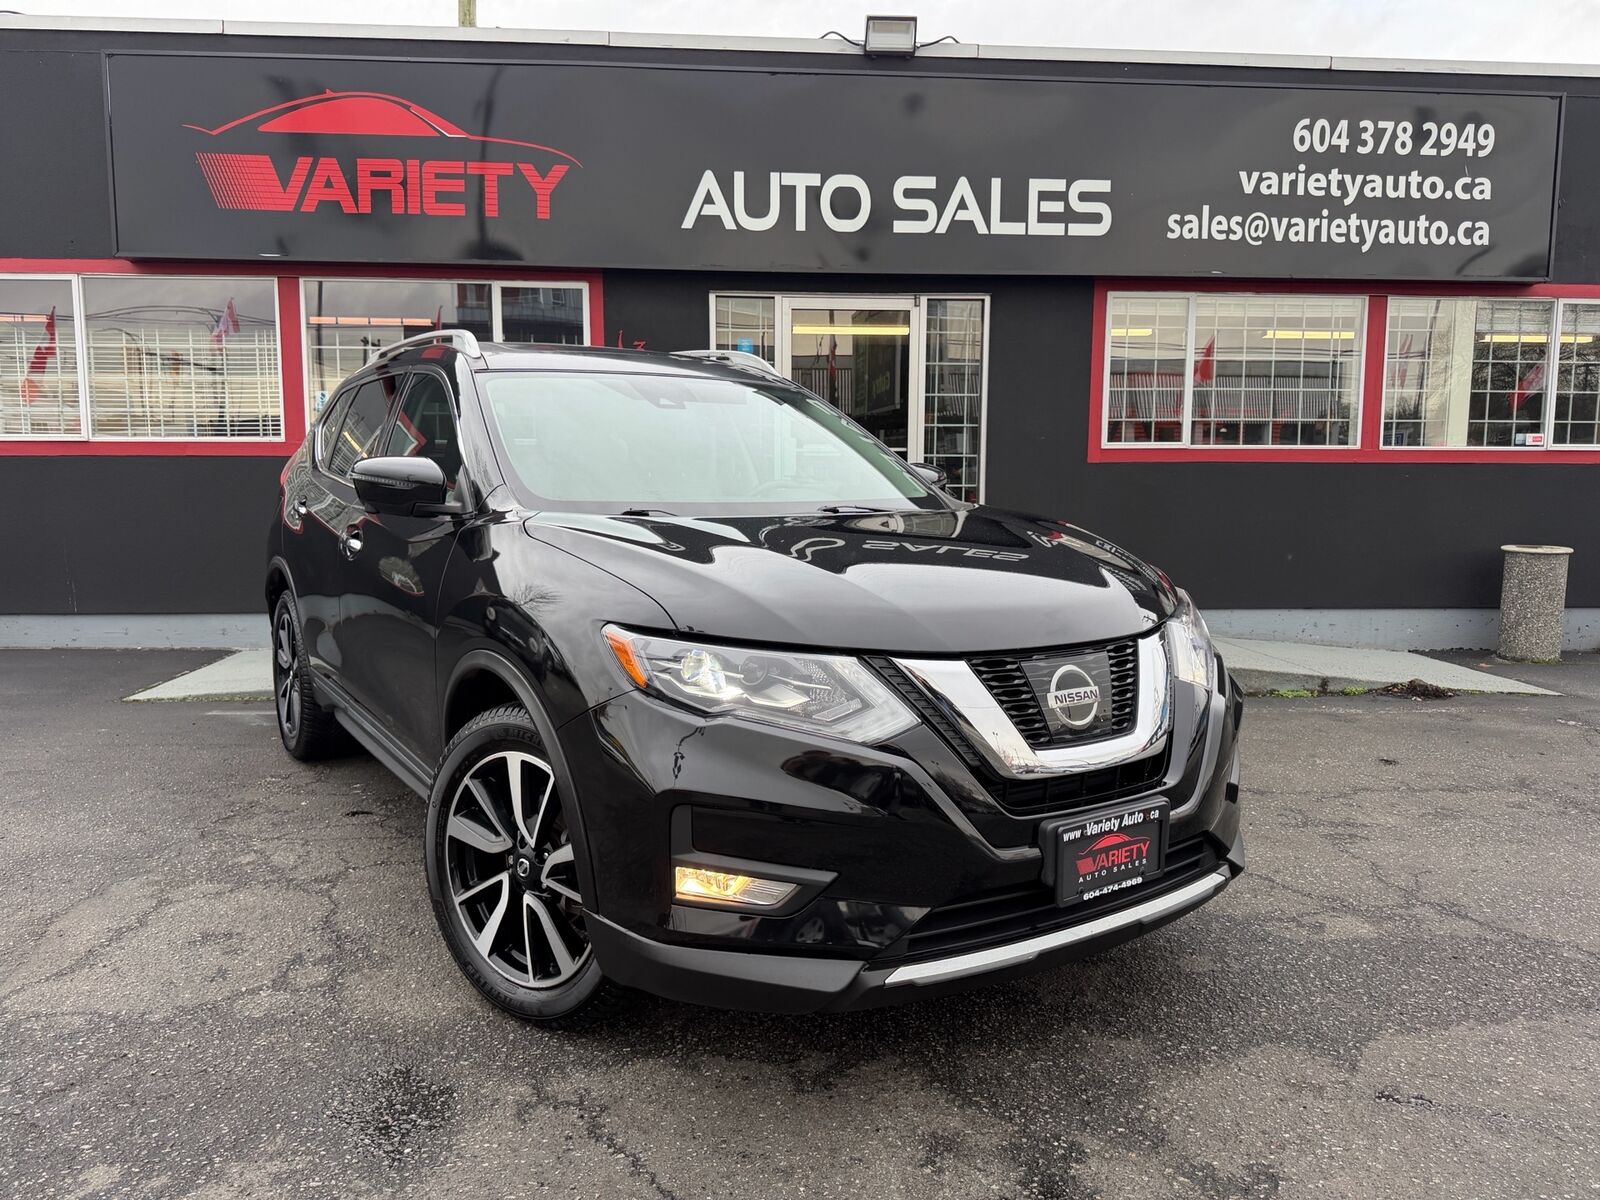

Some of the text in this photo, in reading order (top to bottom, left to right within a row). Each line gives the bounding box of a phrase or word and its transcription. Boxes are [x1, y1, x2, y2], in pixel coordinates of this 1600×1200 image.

[1293, 118, 1496, 157] 604 378 2949
[195, 152, 570, 220] VARIETY
[681, 169, 1113, 236] AUTO SALES
[1239, 164, 1493, 206] varietyauto.ca
[1166, 205, 1491, 253] sales@varietyauto.ca
[1054, 689, 1098, 705] NISSAN
[1063, 829, 1082, 842] www
[1086, 817, 1120, 836] Variety
[1121, 812, 1144, 827] Auto
[1076, 840, 1151, 875] VARIETY
[1078, 858, 1147, 883] AUTO SALES
[1083, 876, 1143, 901] 604-474-4969
